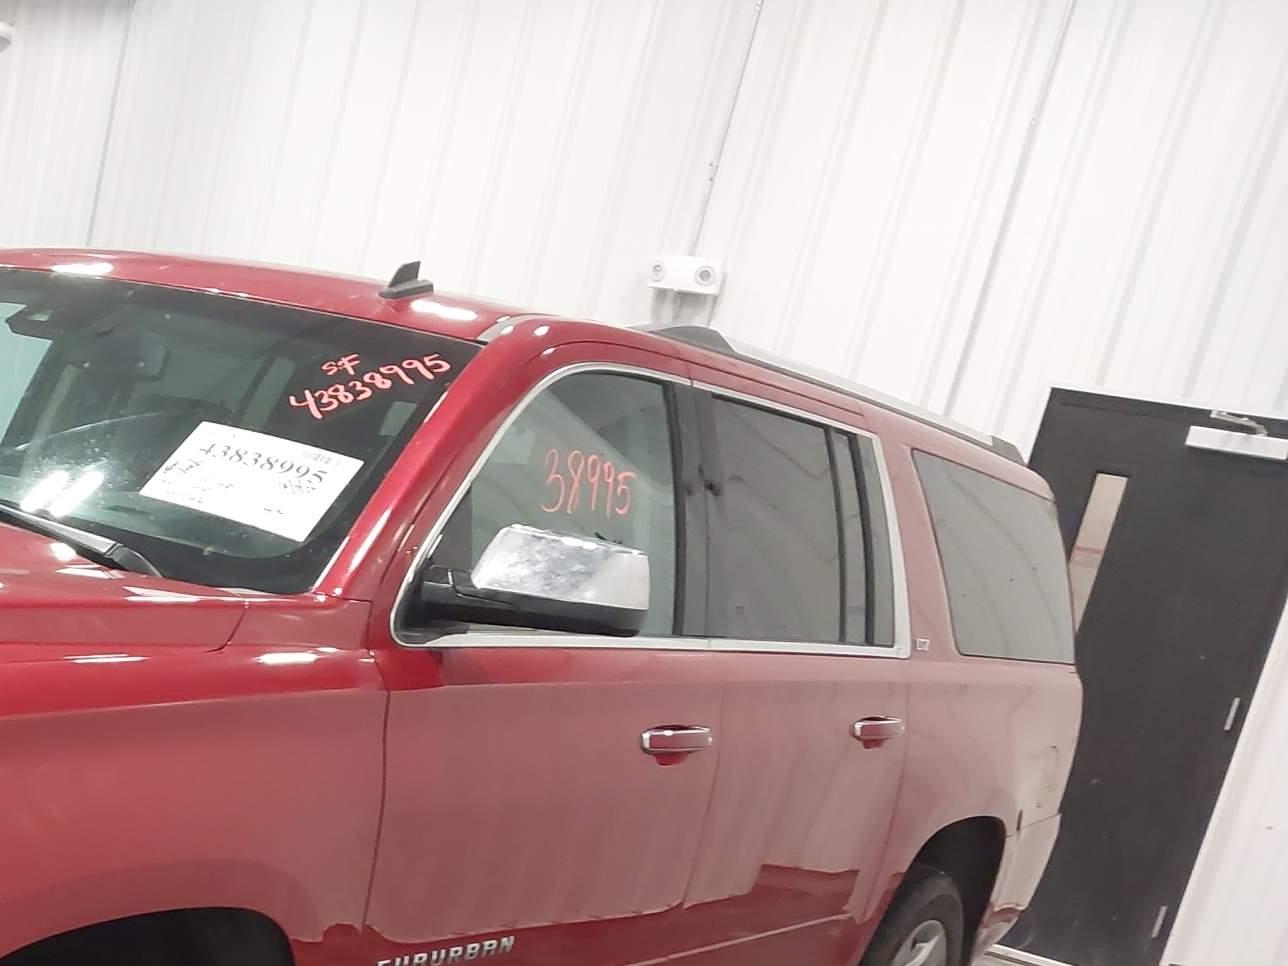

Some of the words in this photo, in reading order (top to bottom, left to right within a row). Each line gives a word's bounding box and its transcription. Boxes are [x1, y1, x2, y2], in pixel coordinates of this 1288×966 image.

[288, 353, 451, 420] 43838995
[198, 442, 329, 485] 43838995
[540, 448, 637, 519] 38995
